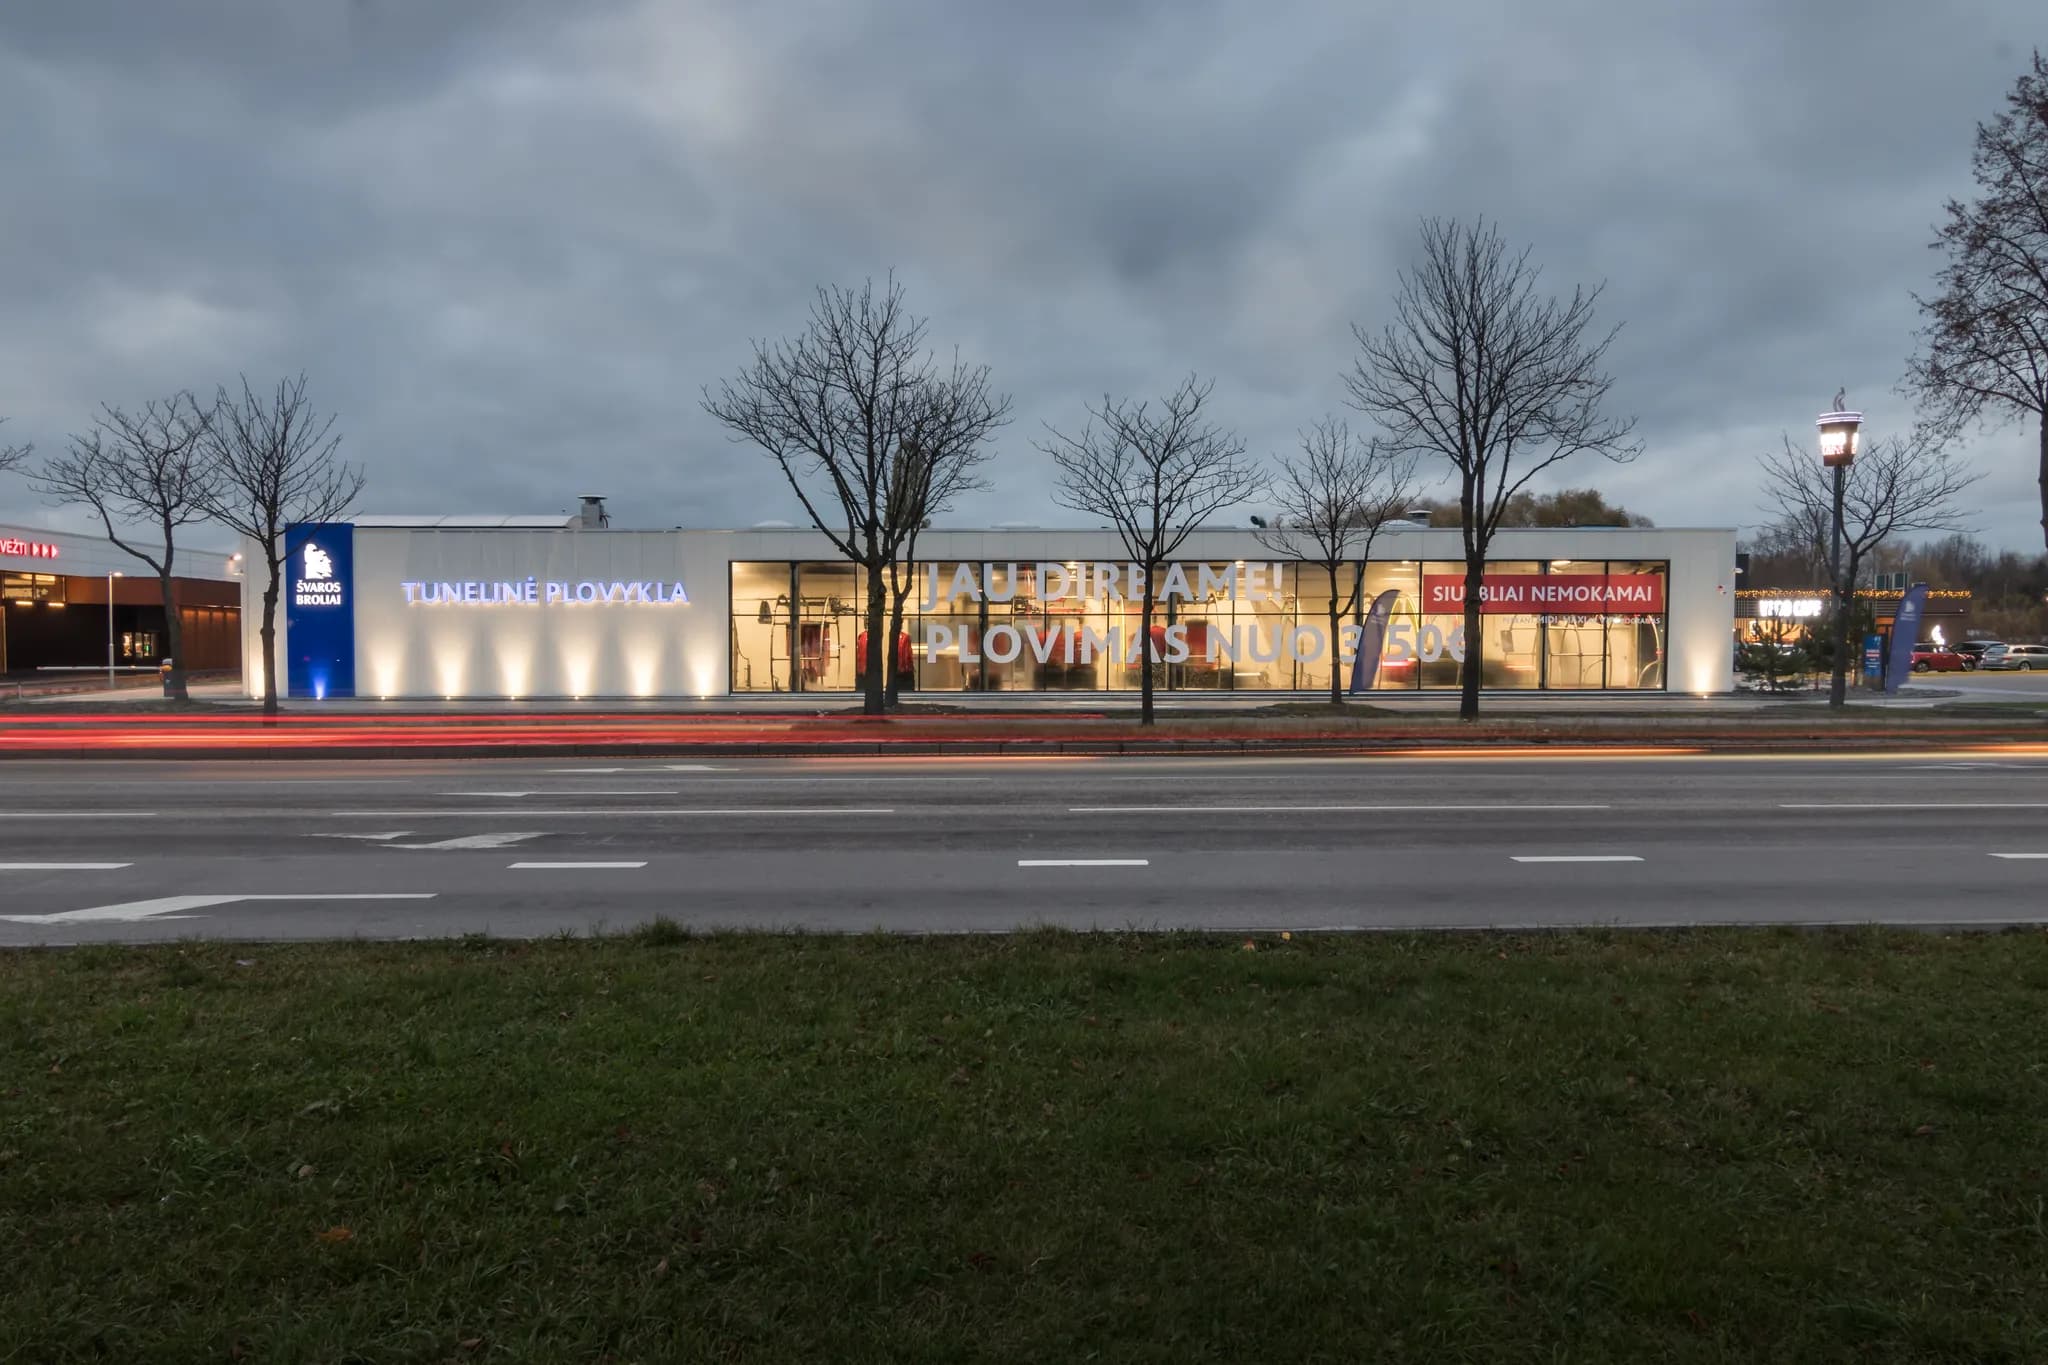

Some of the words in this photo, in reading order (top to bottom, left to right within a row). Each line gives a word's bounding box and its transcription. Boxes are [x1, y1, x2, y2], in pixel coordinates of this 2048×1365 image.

[296, 580, 341, 592] ŠVAROS
[401, 577, 538, 603] TUNELINĖ
[546, 582, 689, 603] PLOVYKLA
[921, 563, 1016, 611] JAU
[1037, 563, 1283, 601] DIRBAME!
[1433, 586, 1524, 601] SIUBLIAI
[1531, 586, 1652, 601] NEMOKAMAI
[296, 594, 341, 605] BROLIAI
[927, 624, 1189, 664] PLOVIMAS
[1206, 624, 1325, 663] NUO
